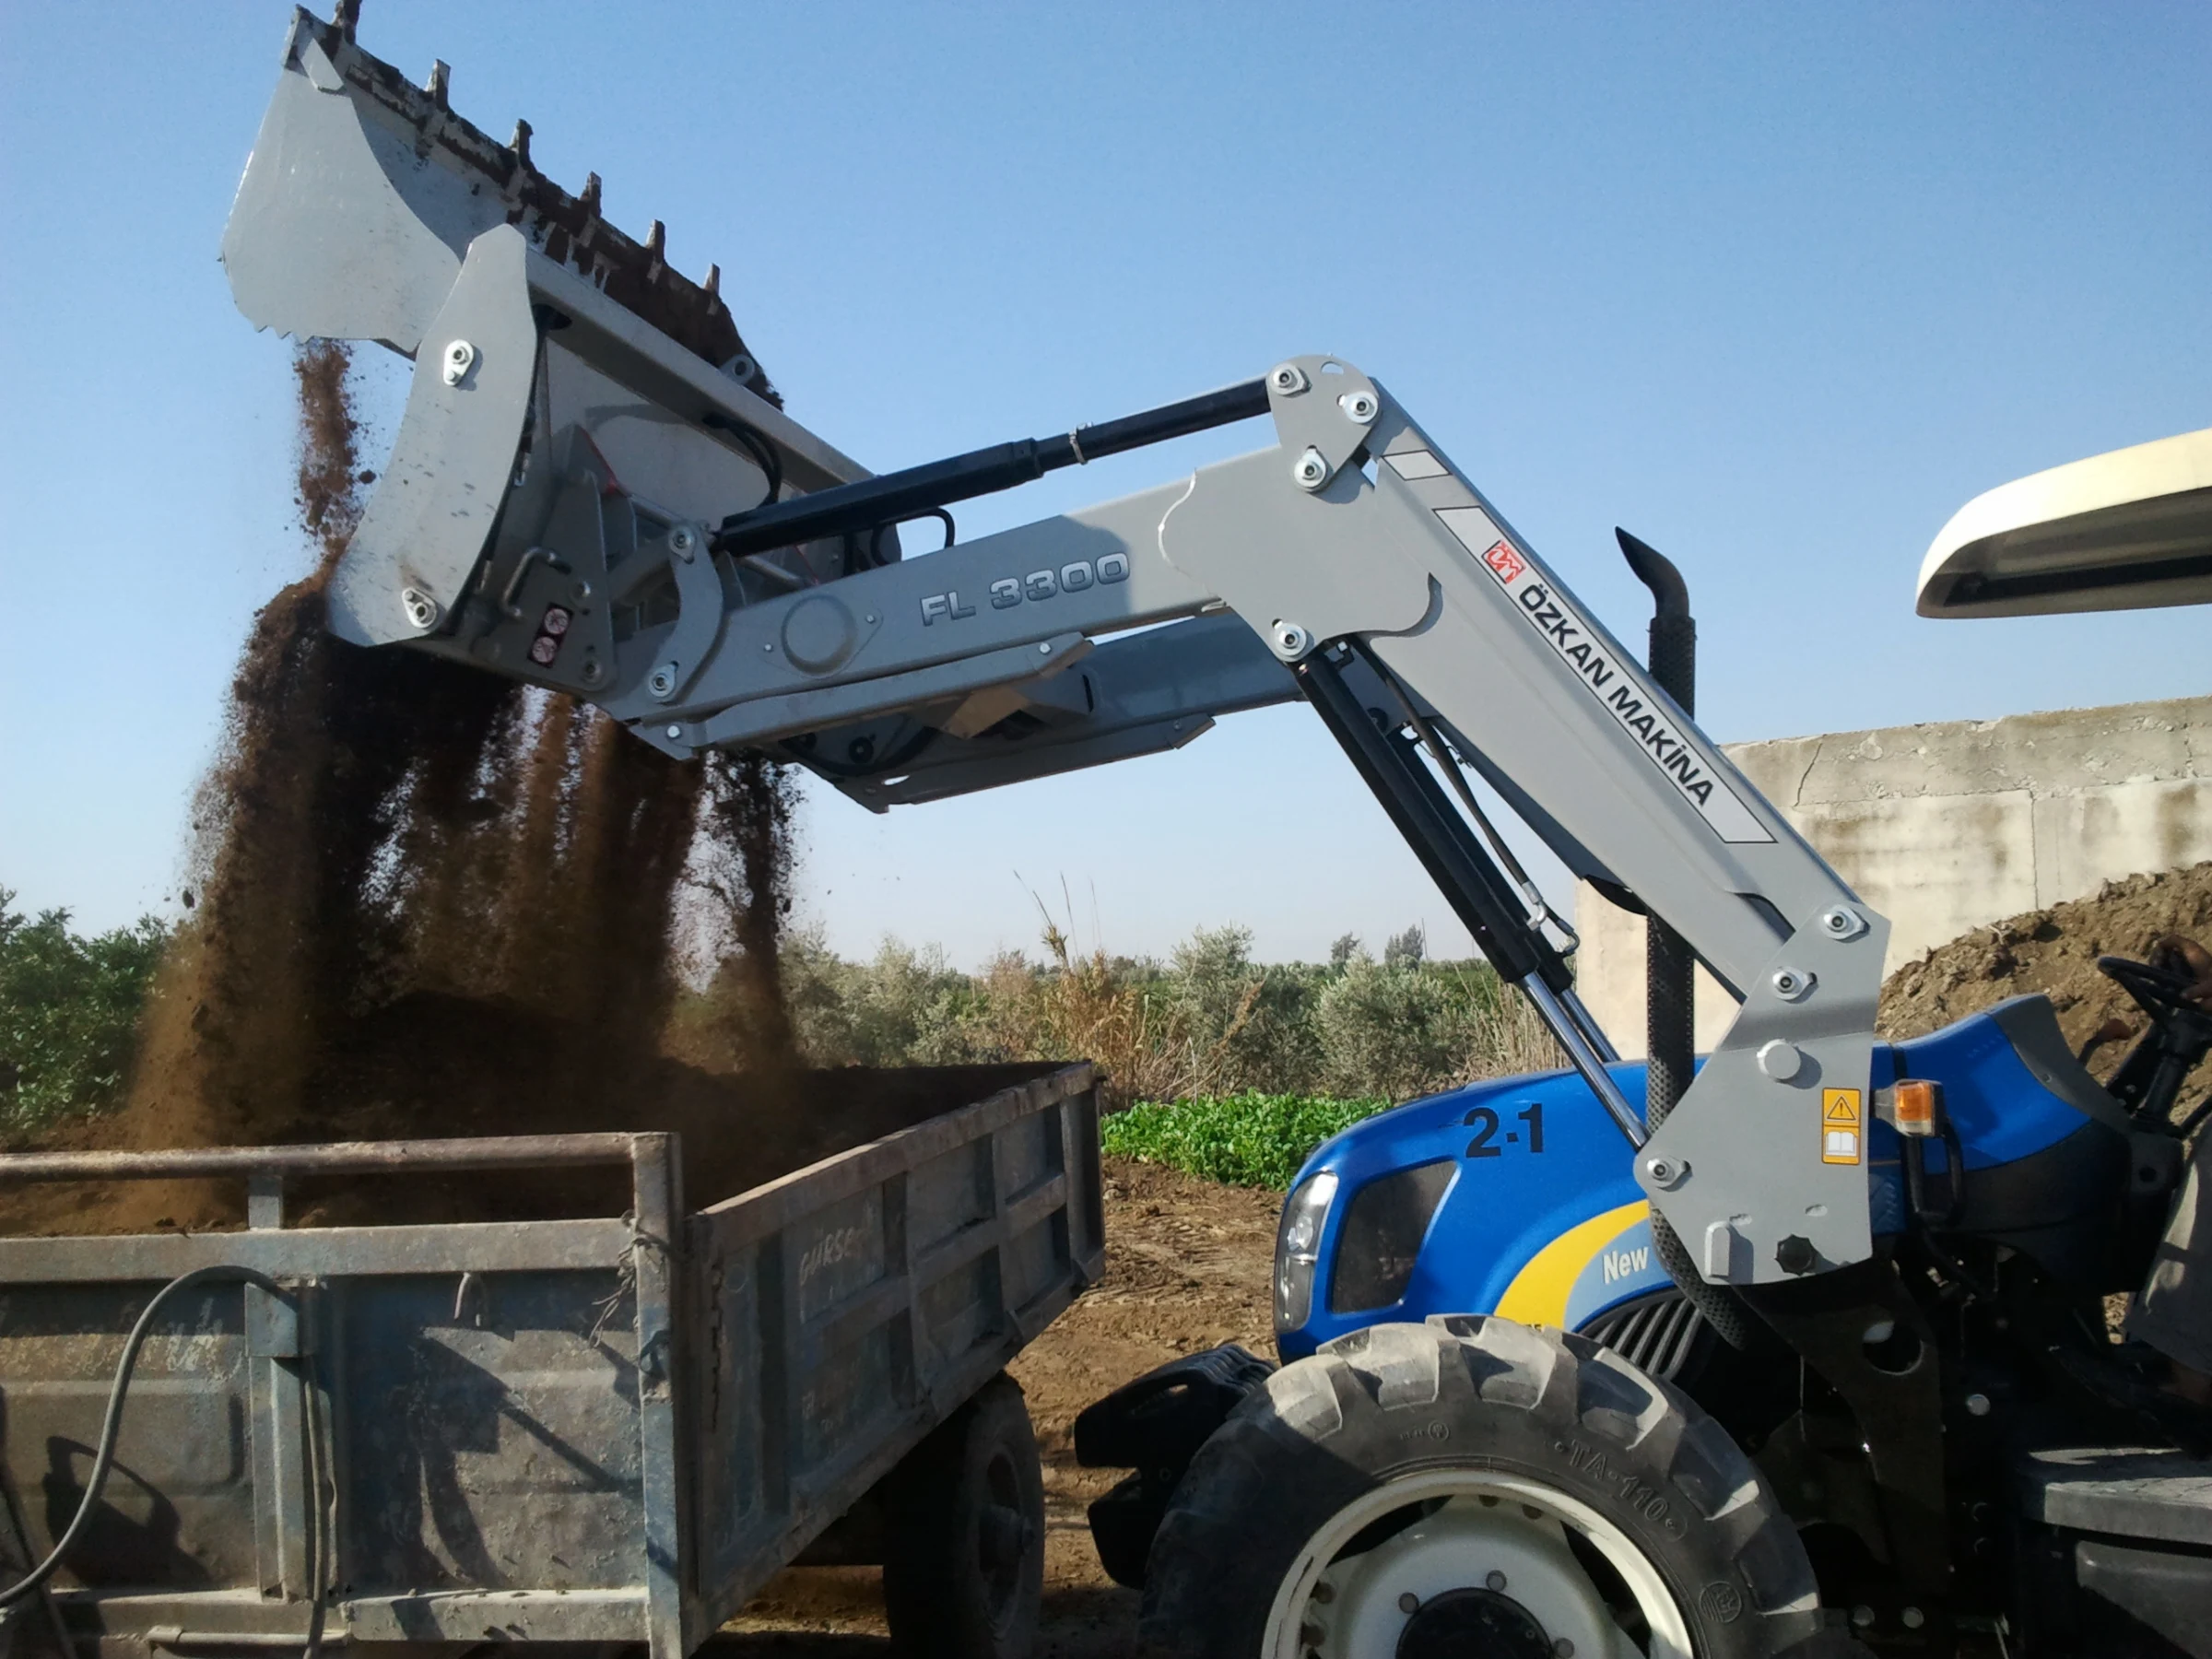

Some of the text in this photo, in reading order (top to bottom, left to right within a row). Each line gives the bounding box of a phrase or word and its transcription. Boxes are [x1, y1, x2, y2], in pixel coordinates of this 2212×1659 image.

[920, 552, 1130, 627] FL 3300
[1519, 583, 1615, 688] ÖZKAN
[1603, 1246, 1649, 1285] New
